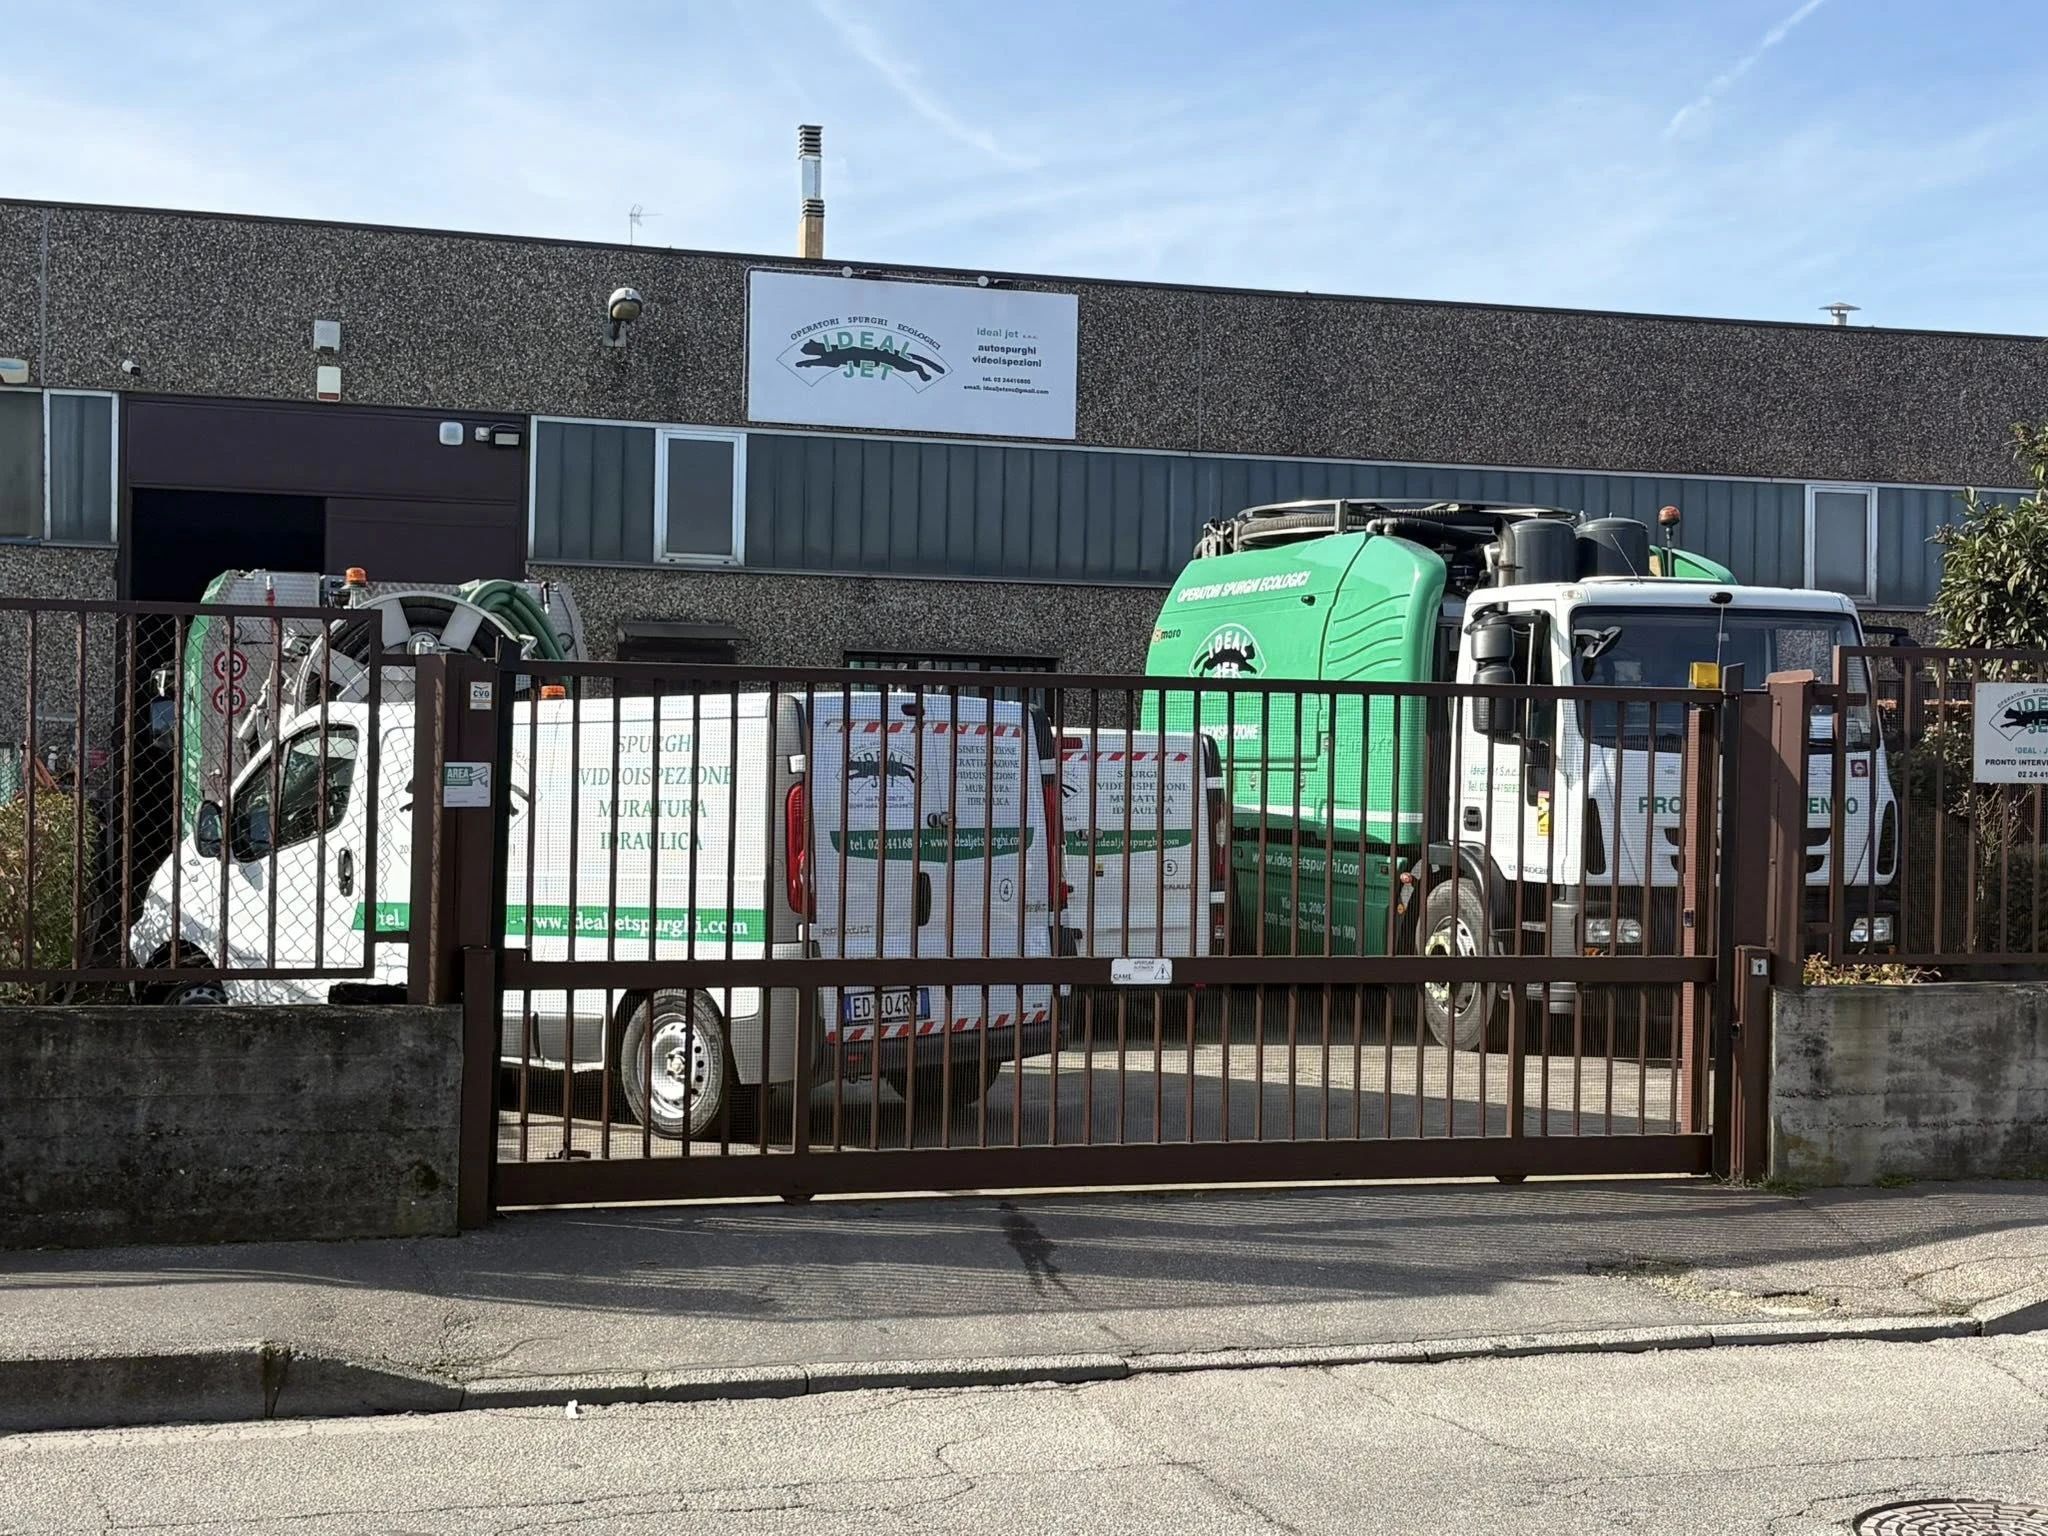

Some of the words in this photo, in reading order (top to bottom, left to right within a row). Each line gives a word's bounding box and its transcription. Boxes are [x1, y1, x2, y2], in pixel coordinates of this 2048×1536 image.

[790, 318, 839, 341] OPERATORI
[847, 316, 888, 327] SPURGHI
[897, 323, 941, 351] ECOLOGICI
[976, 327, 1002, 337] ideal
[1004, 329, 1019, 339] jet
[822, 330, 912, 361] IDEAL
[977, 344, 1037, 356] autospurghi
[972, 356, 1042, 368] videoispezioni
[842, 359, 893, 381] JET
[1176, 583, 1224, 603] OPERATORI
[1220, 577, 1259, 598] SPURGHI
[1257, 570, 1312, 593] ECOLOGICI
[1160, 627, 1182, 640] moro
[1208, 630, 1249, 659] IDEAL
[218, 694, 240, 706] 10
[618, 734, 697, 754] SPUGH
[1985, 758, 2017, 766] PRONTO
[446, 767, 470, 780] AREA
[850, 837, 866, 851] tel.
[378, 907, 406, 928] tel.
